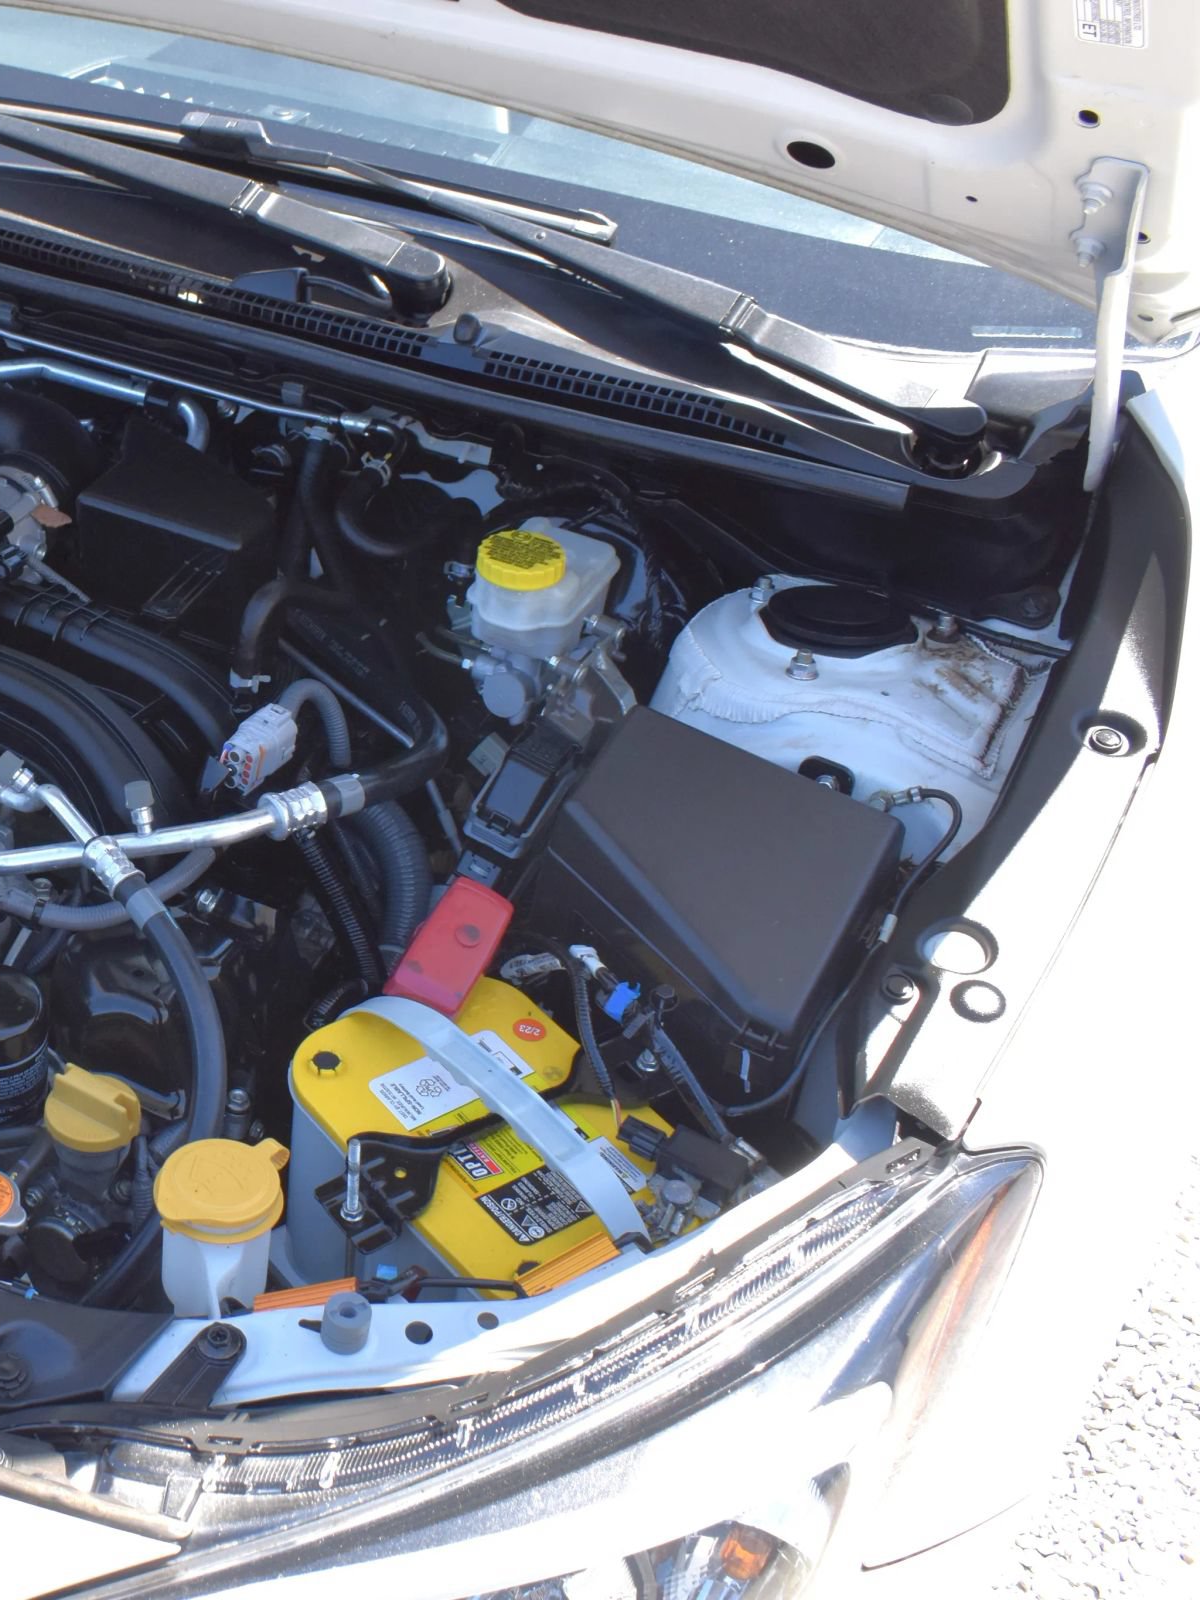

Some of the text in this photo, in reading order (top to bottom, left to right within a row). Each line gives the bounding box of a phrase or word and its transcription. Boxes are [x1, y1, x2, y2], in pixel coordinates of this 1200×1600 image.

[1082, 23, 1097, 38] ET
[519, 1024, 541, 1036] 2/23
[390, 1083, 422, 1115] NON-SPILLABLE
[479, 1195, 523, 1236] DANGER/POISON
